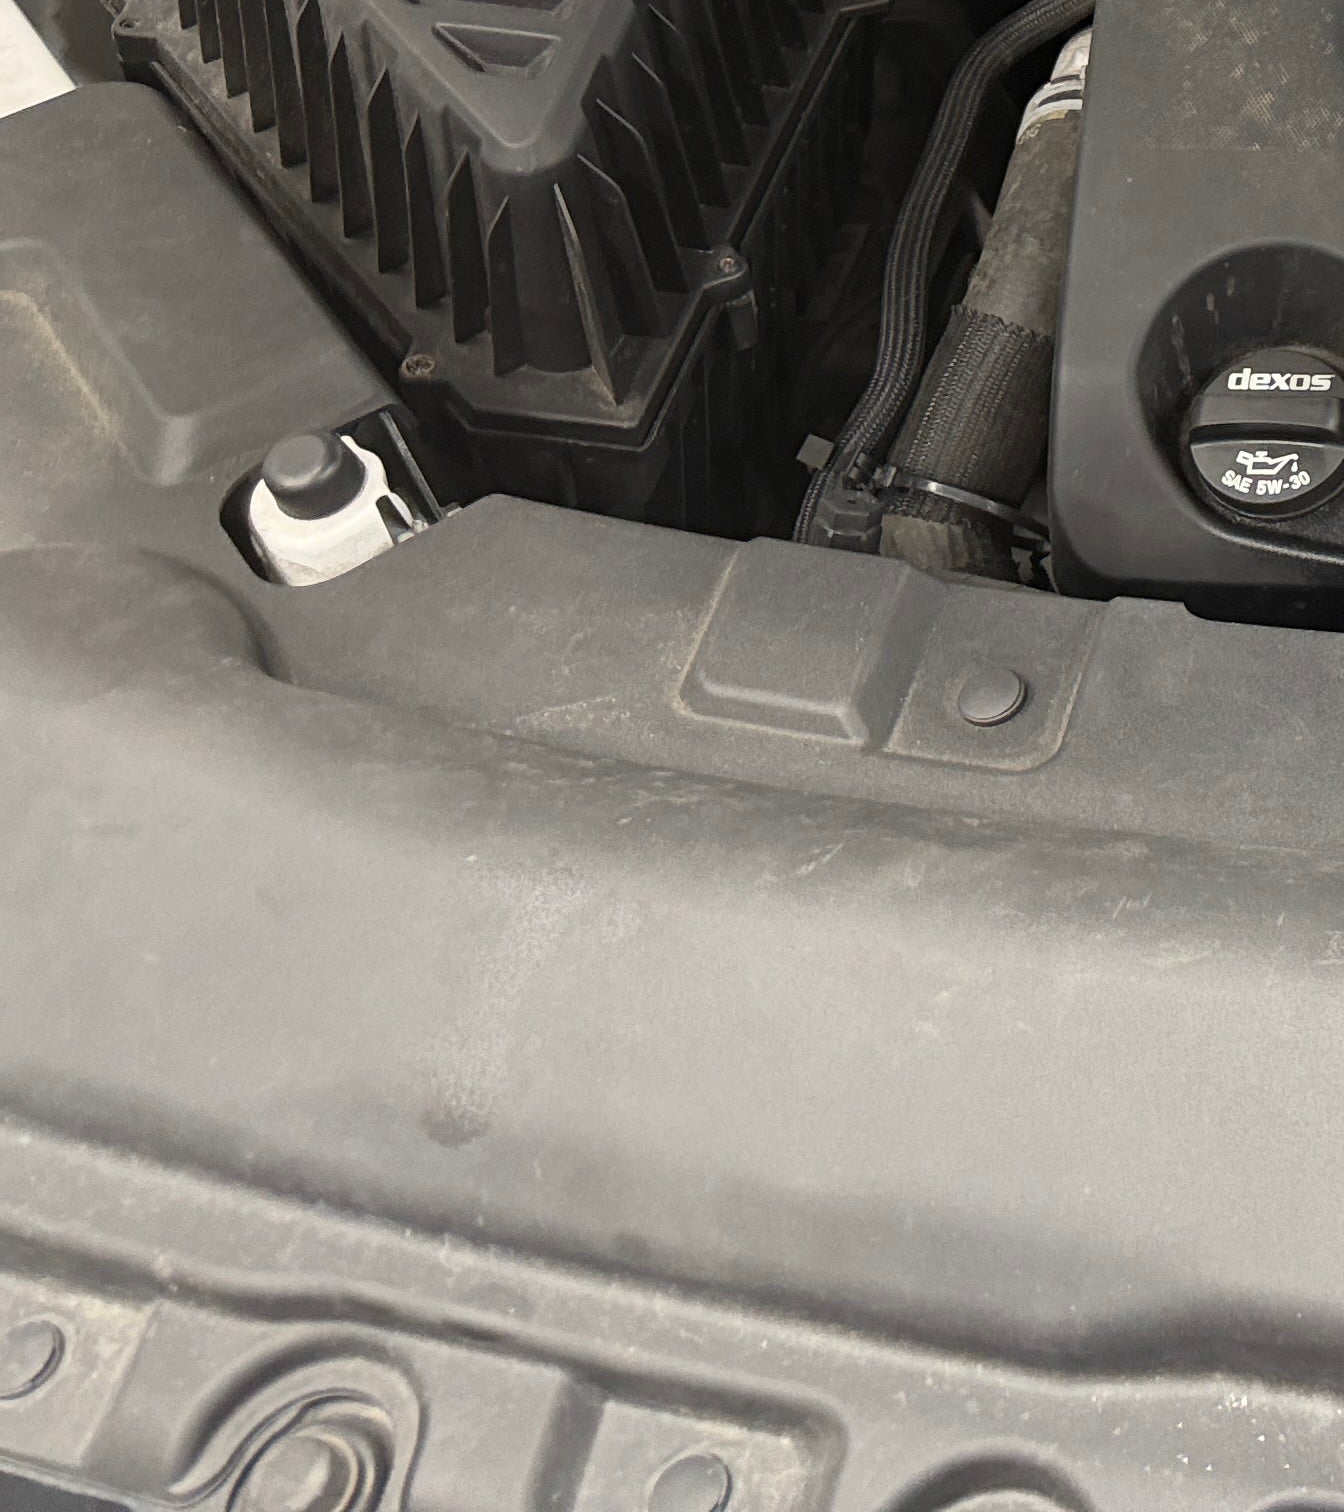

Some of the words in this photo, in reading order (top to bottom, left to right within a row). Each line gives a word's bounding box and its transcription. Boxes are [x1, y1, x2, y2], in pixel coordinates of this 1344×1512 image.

[1227, 367, 1336, 391] dexos
[1221, 469, 1253, 494] SAE
[1255, 470, 1311, 495] 5W-30
